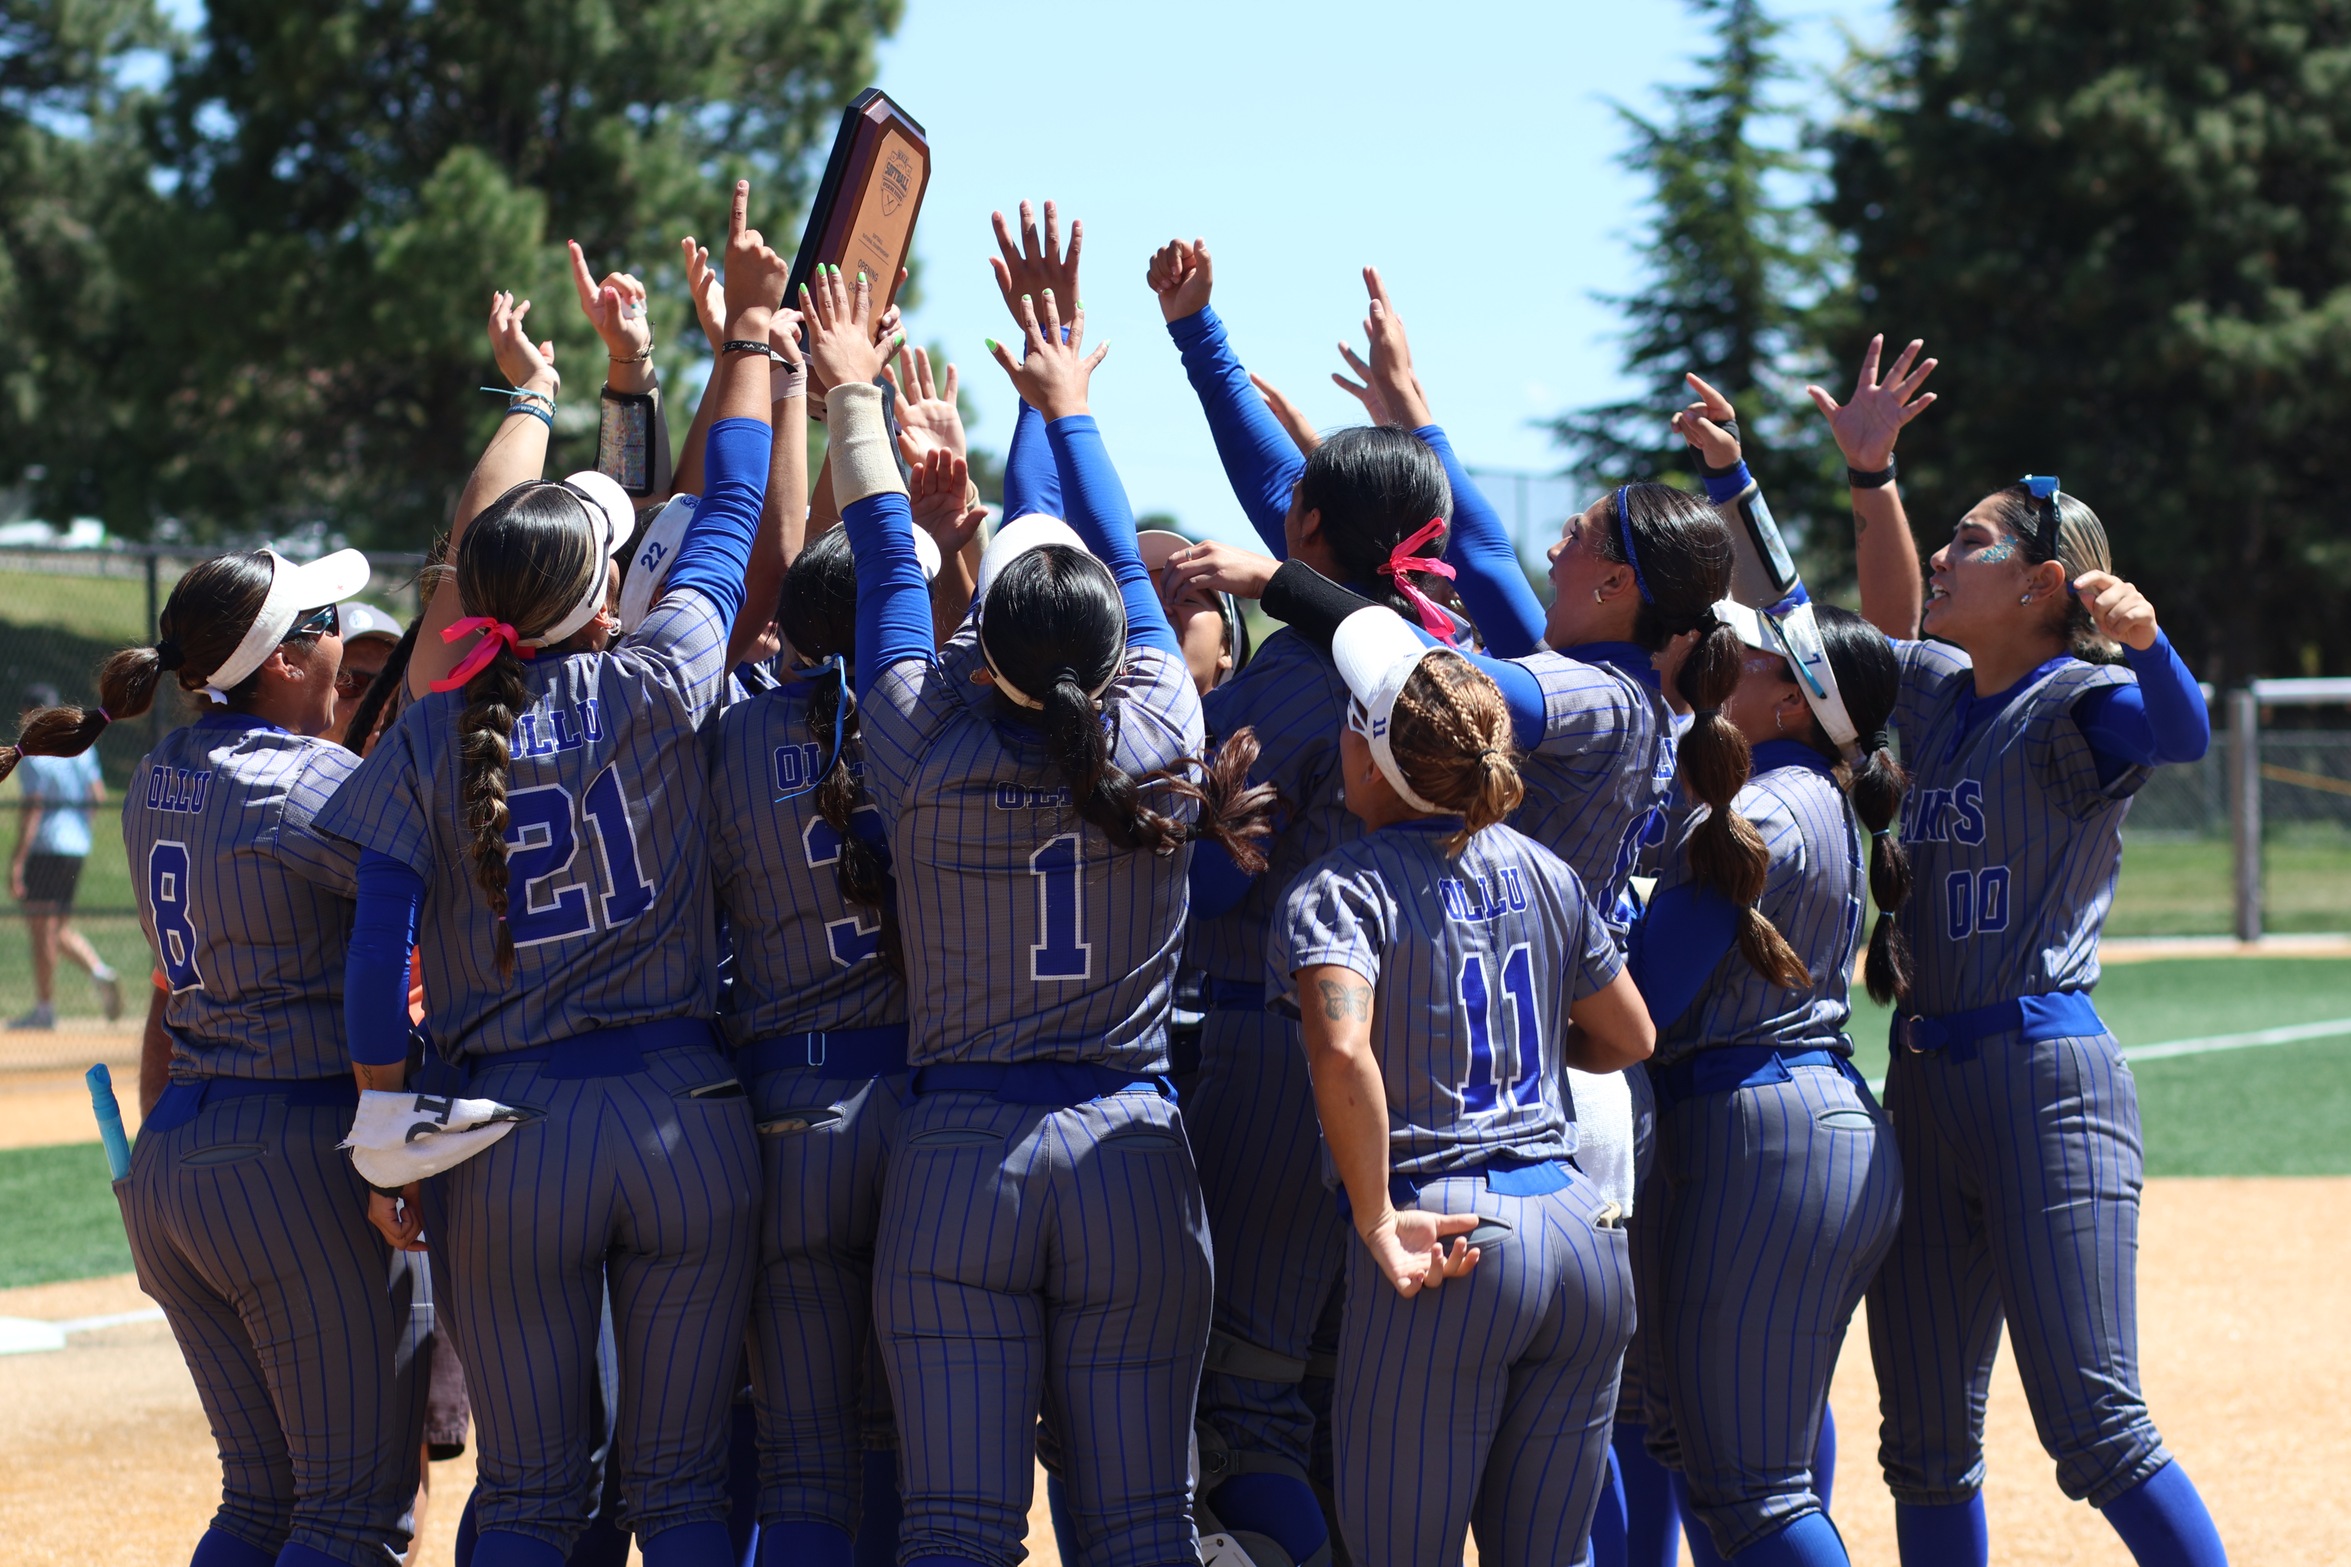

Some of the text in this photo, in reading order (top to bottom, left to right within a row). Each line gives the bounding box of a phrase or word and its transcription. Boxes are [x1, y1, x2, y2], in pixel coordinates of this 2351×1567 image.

[885, 161, 909, 190] SOFTBALL
[858, 258, 879, 282] OPENING
[640, 541, 668, 573] 22
[1373, 717, 1387, 740] 11
[147, 765, 212, 814] OLLU
[506, 760, 657, 948] 21
[149, 839, 205, 996] 8
[1029, 832, 1092, 981] 1
[1438, 866, 1528, 922] OLLU
[1945, 865, 2011, 941] 00
[1456, 941, 1545, 1120] 11
